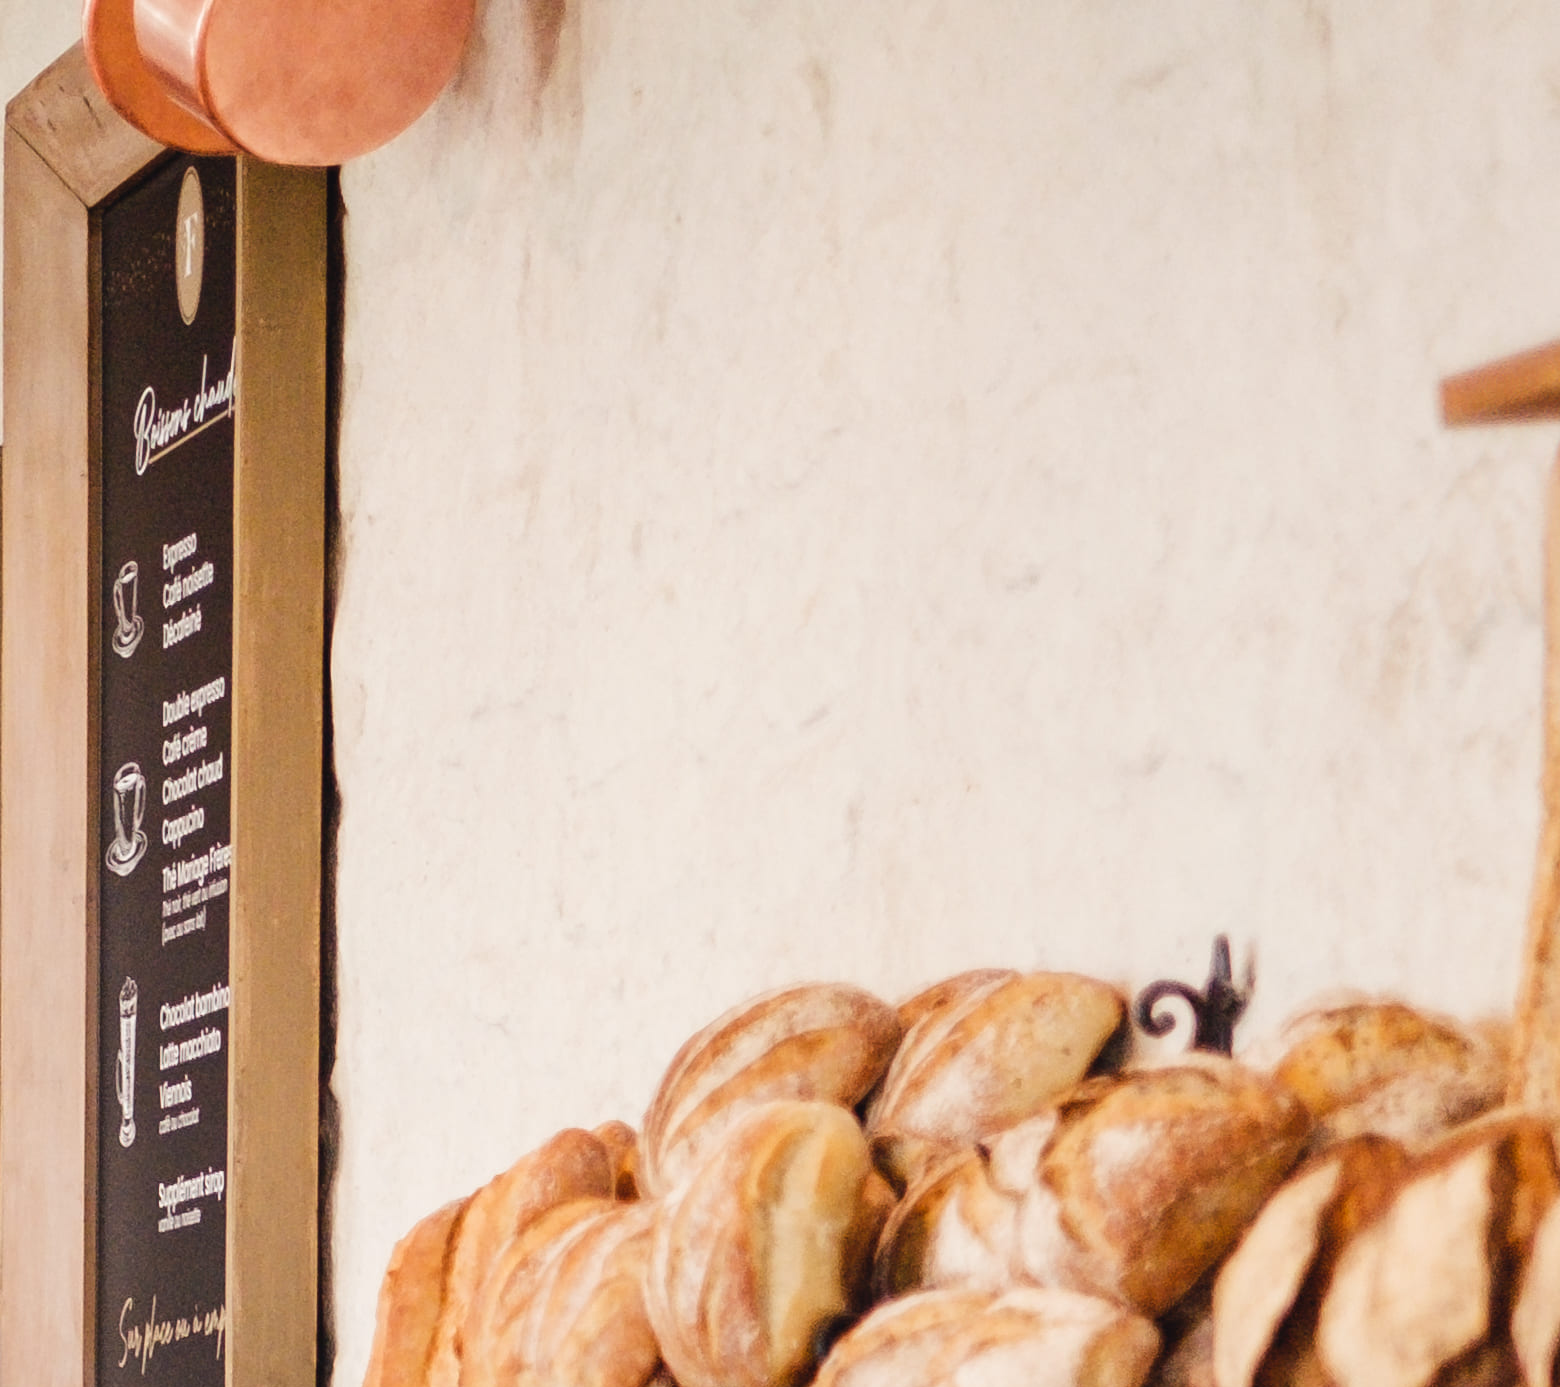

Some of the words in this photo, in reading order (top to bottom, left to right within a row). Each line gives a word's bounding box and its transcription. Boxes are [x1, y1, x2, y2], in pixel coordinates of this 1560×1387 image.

[184, 211, 199, 278] F
[163, 574, 182, 609] Café
[182, 561, 214, 599] noisette
[162, 690, 190, 727] Double
[190, 676, 225, 717] expresso
[162, 731, 182, 767] Café
[182, 725, 208, 757] crème
[162, 767, 197, 805] Chocolat
[197, 752, 223, 789] chaud
[159, 995, 195, 1032] Chocolat
[159, 1041, 179, 1071] Latte
[204, 1166, 224, 1201] sirop
